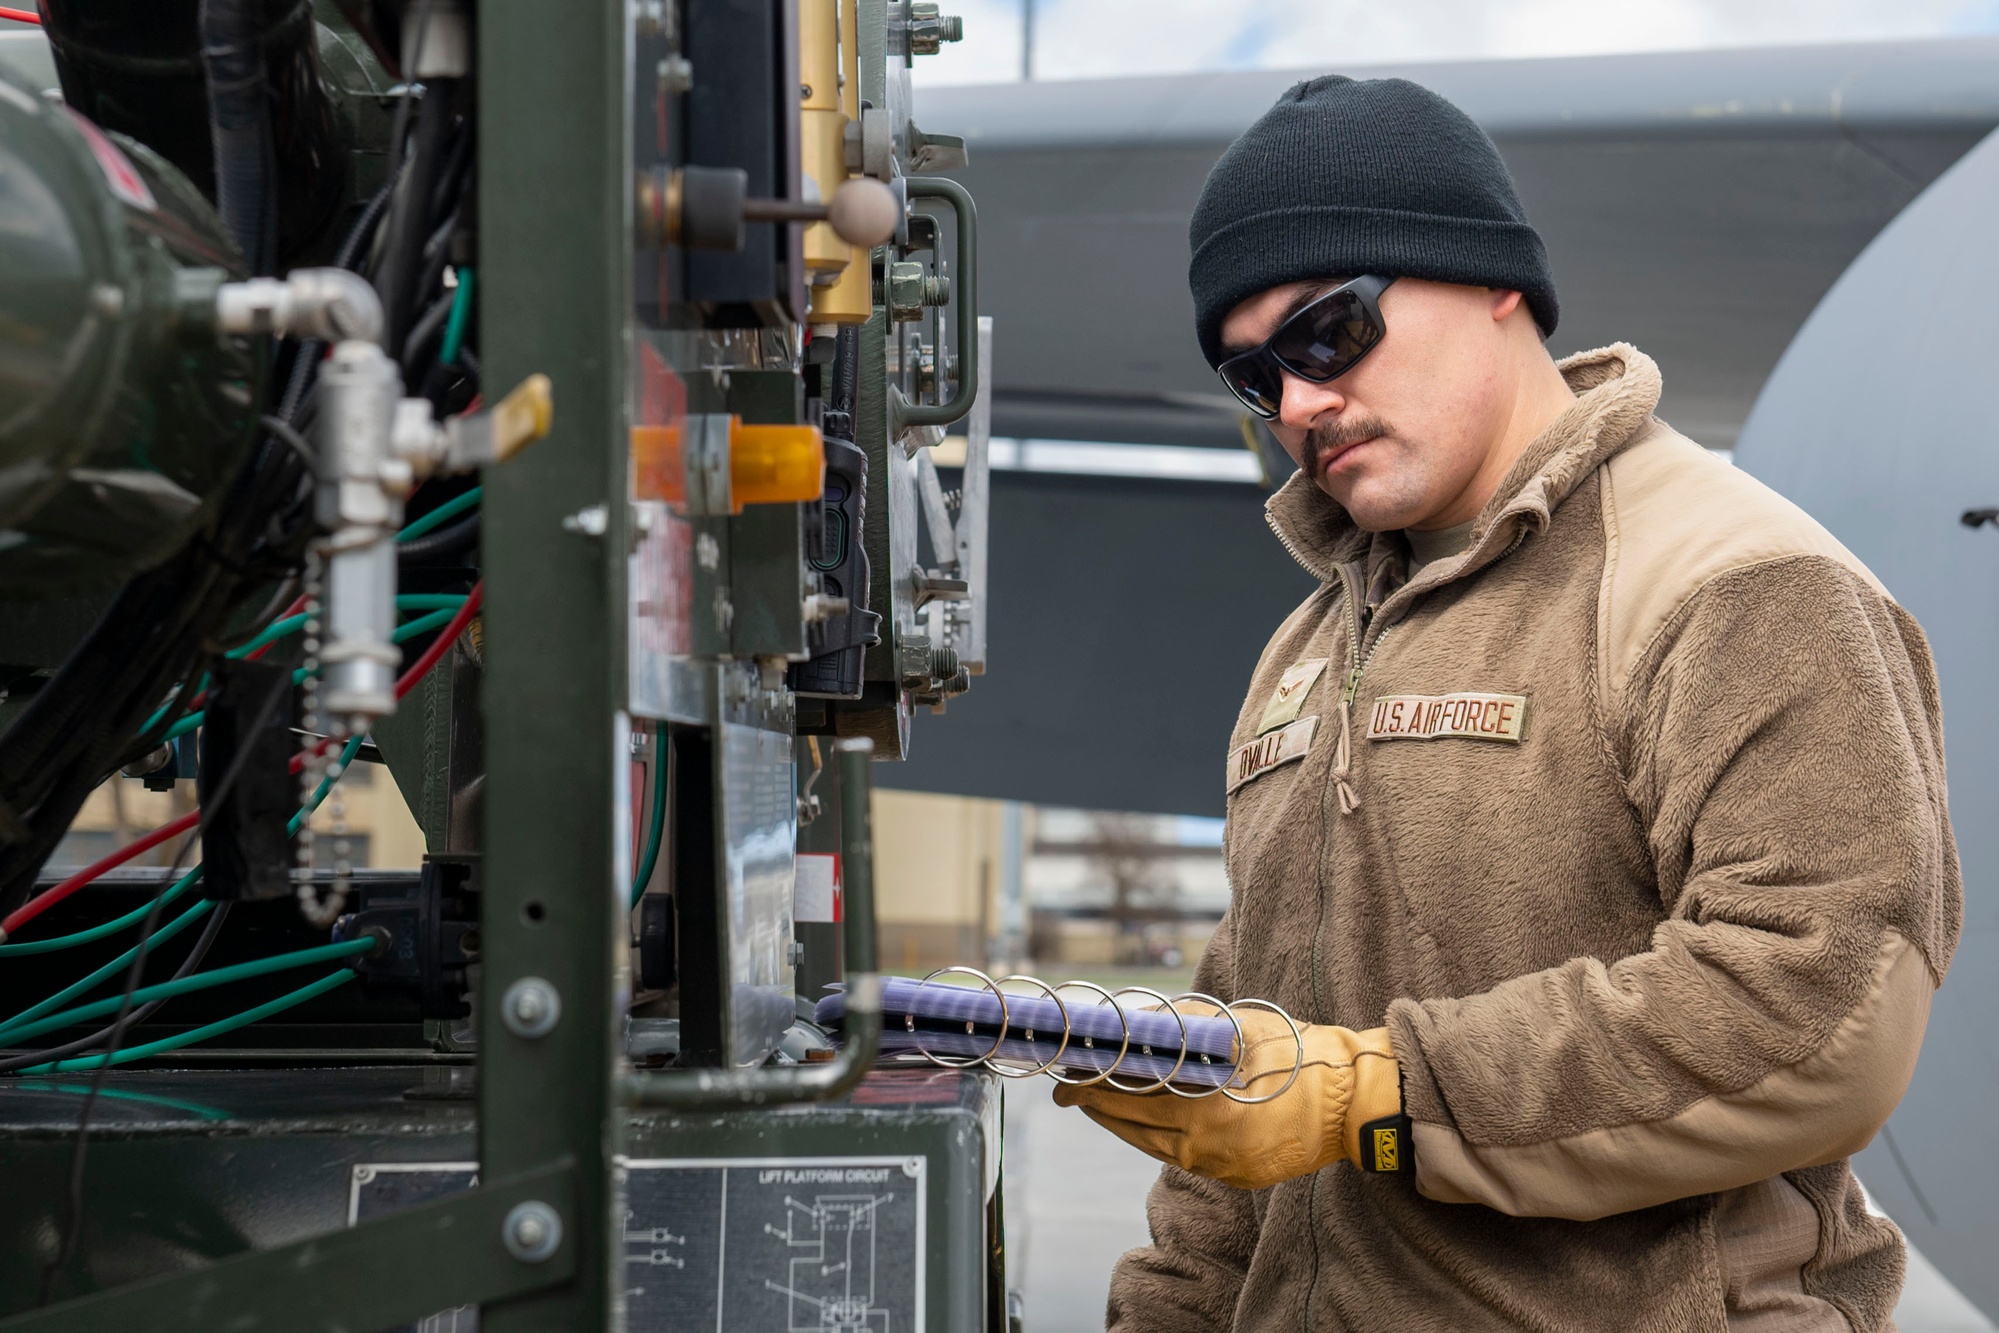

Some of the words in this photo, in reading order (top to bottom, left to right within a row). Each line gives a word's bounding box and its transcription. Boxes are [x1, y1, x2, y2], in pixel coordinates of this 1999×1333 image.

[1373, 702, 1404, 733] U.S.
[758, 1169, 782, 1184] LIFT
[784, 1169, 843, 1184] PLATFORM
[845, 1168, 890, 1183] CIRCUIT
